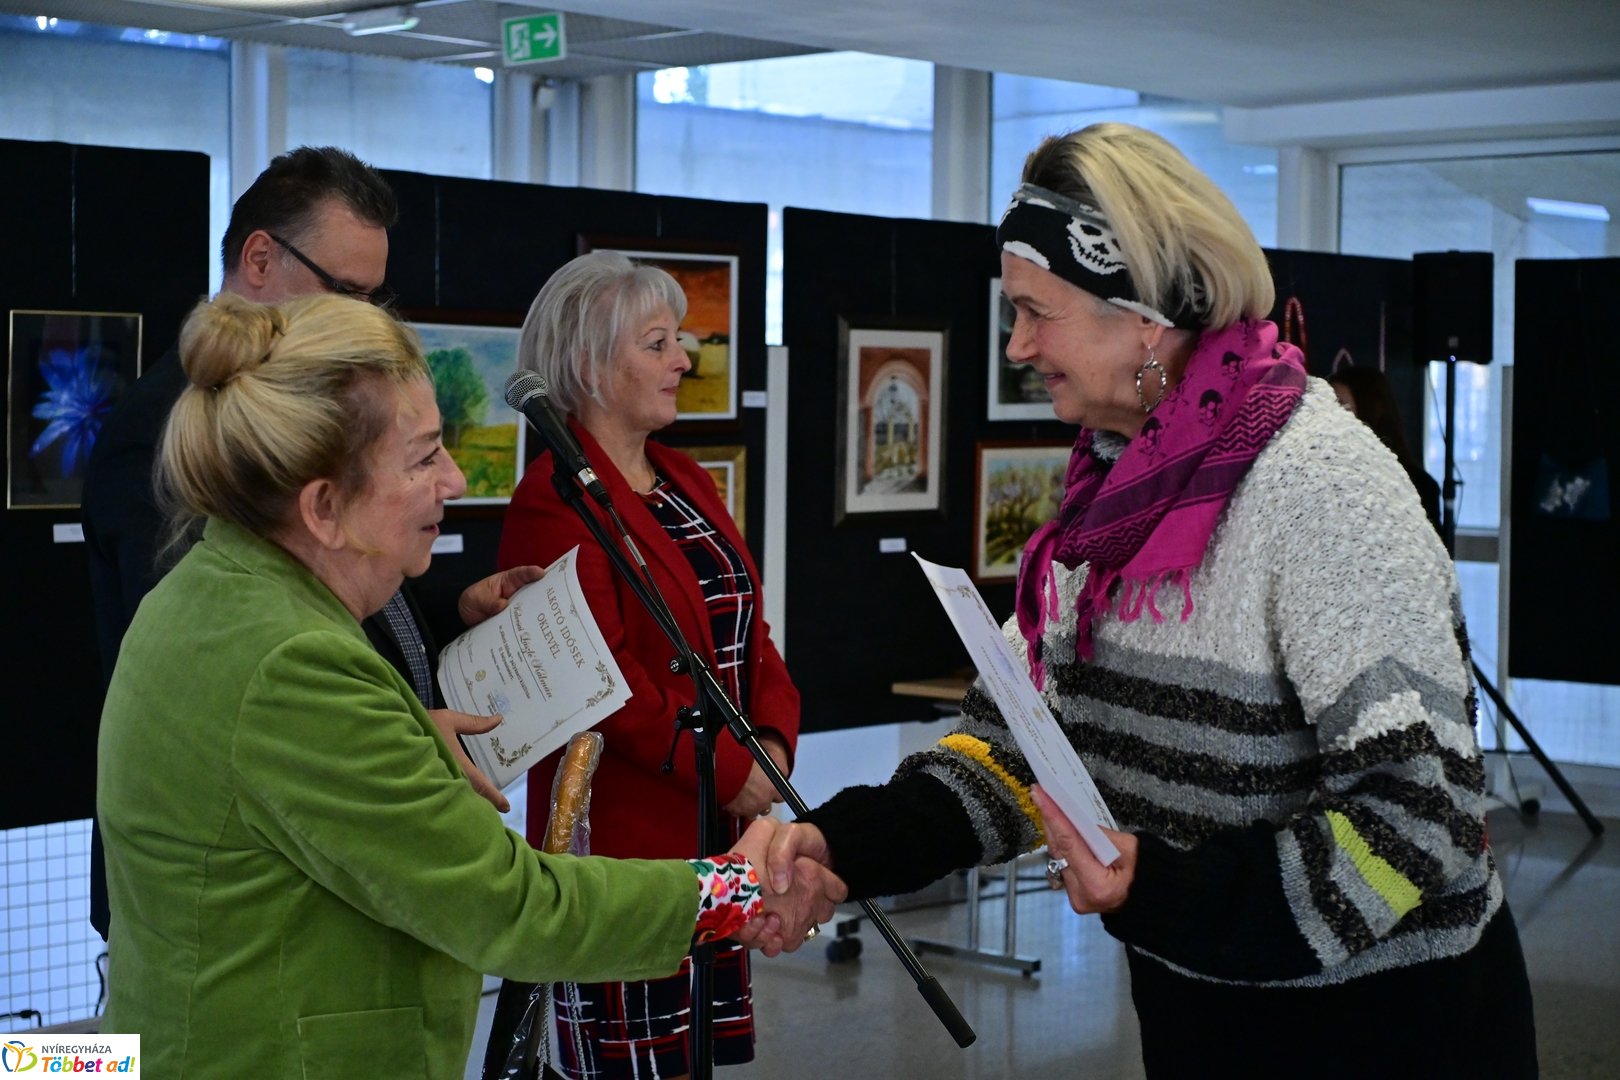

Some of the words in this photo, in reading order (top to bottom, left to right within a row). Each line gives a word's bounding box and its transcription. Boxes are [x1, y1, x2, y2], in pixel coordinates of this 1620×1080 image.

[537, 613, 560, 659] OKLEVÉL
[546, 587, 565, 625] ALKOTÓ
[560, 626, 585, 668] IDŐSEK
